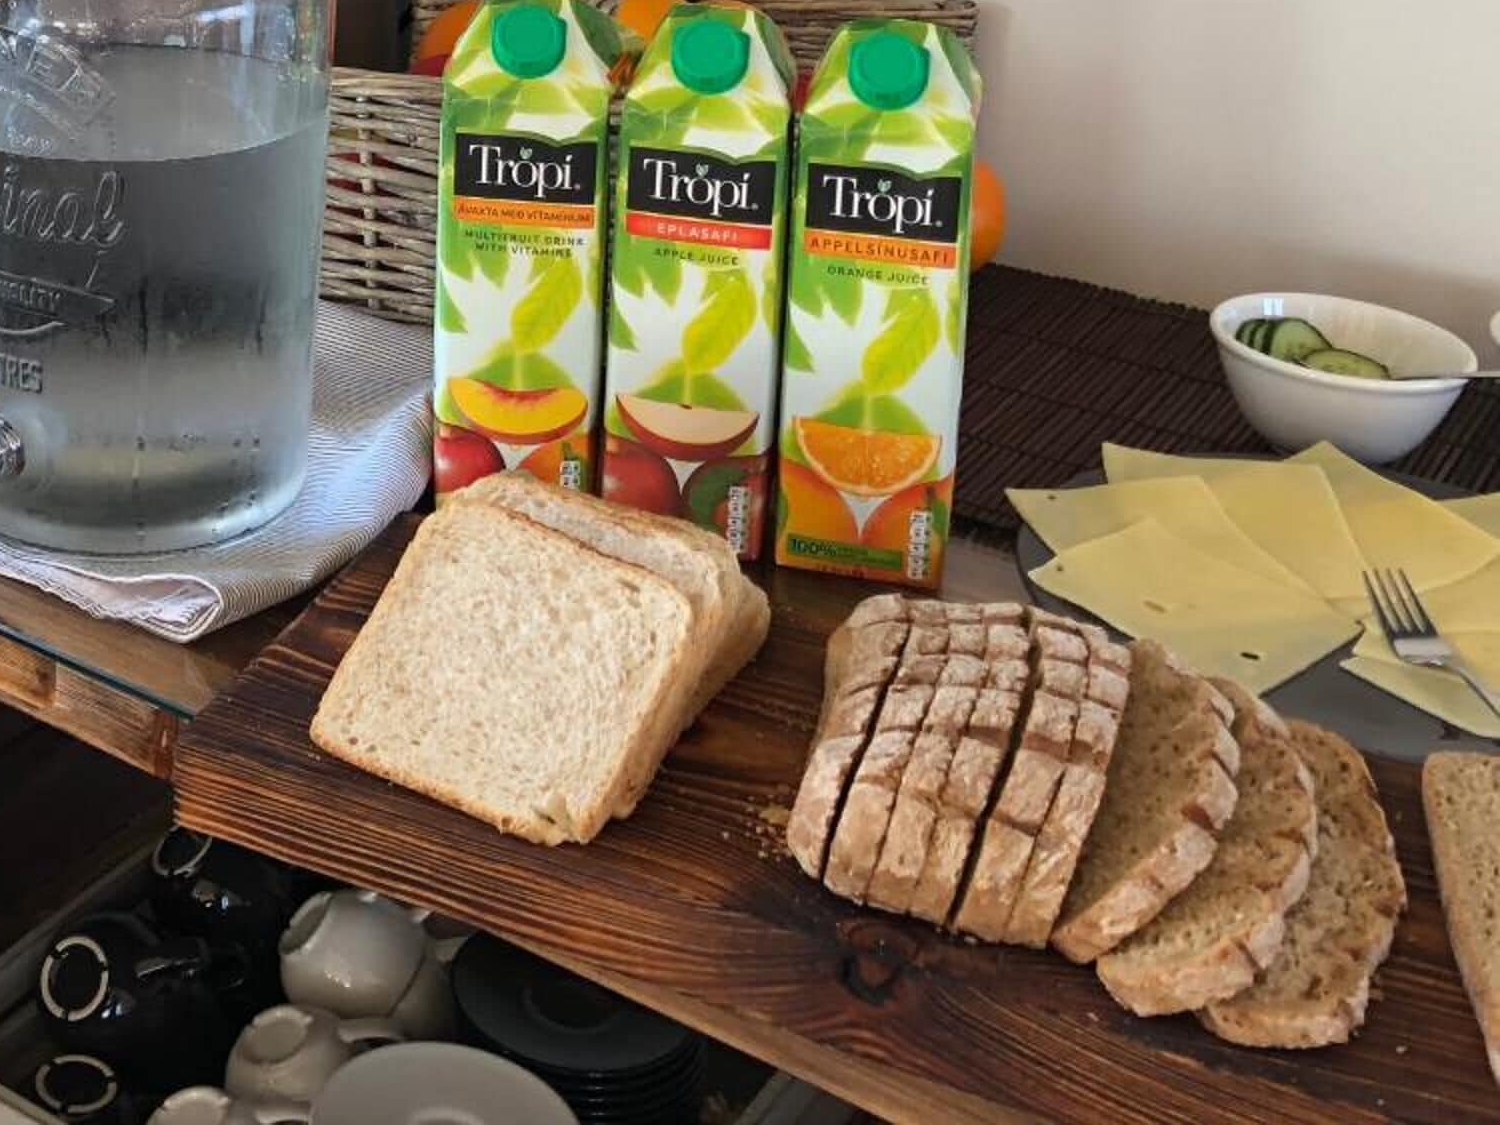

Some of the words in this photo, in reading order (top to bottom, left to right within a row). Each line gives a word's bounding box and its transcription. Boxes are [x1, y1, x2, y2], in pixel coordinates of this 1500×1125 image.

[464, 229, 539, 244] MULTIFRUIT
[544, 235, 586, 246] DRINK
[657, 223, 739, 243] EPLASAFI
[474, 241, 507, 253] WITH
[653, 247, 695, 261] APPLE
[698, 251, 740, 266] JUICE
[826, 265, 883, 282] ORANGE
[887, 272, 930, 286] JUICE
